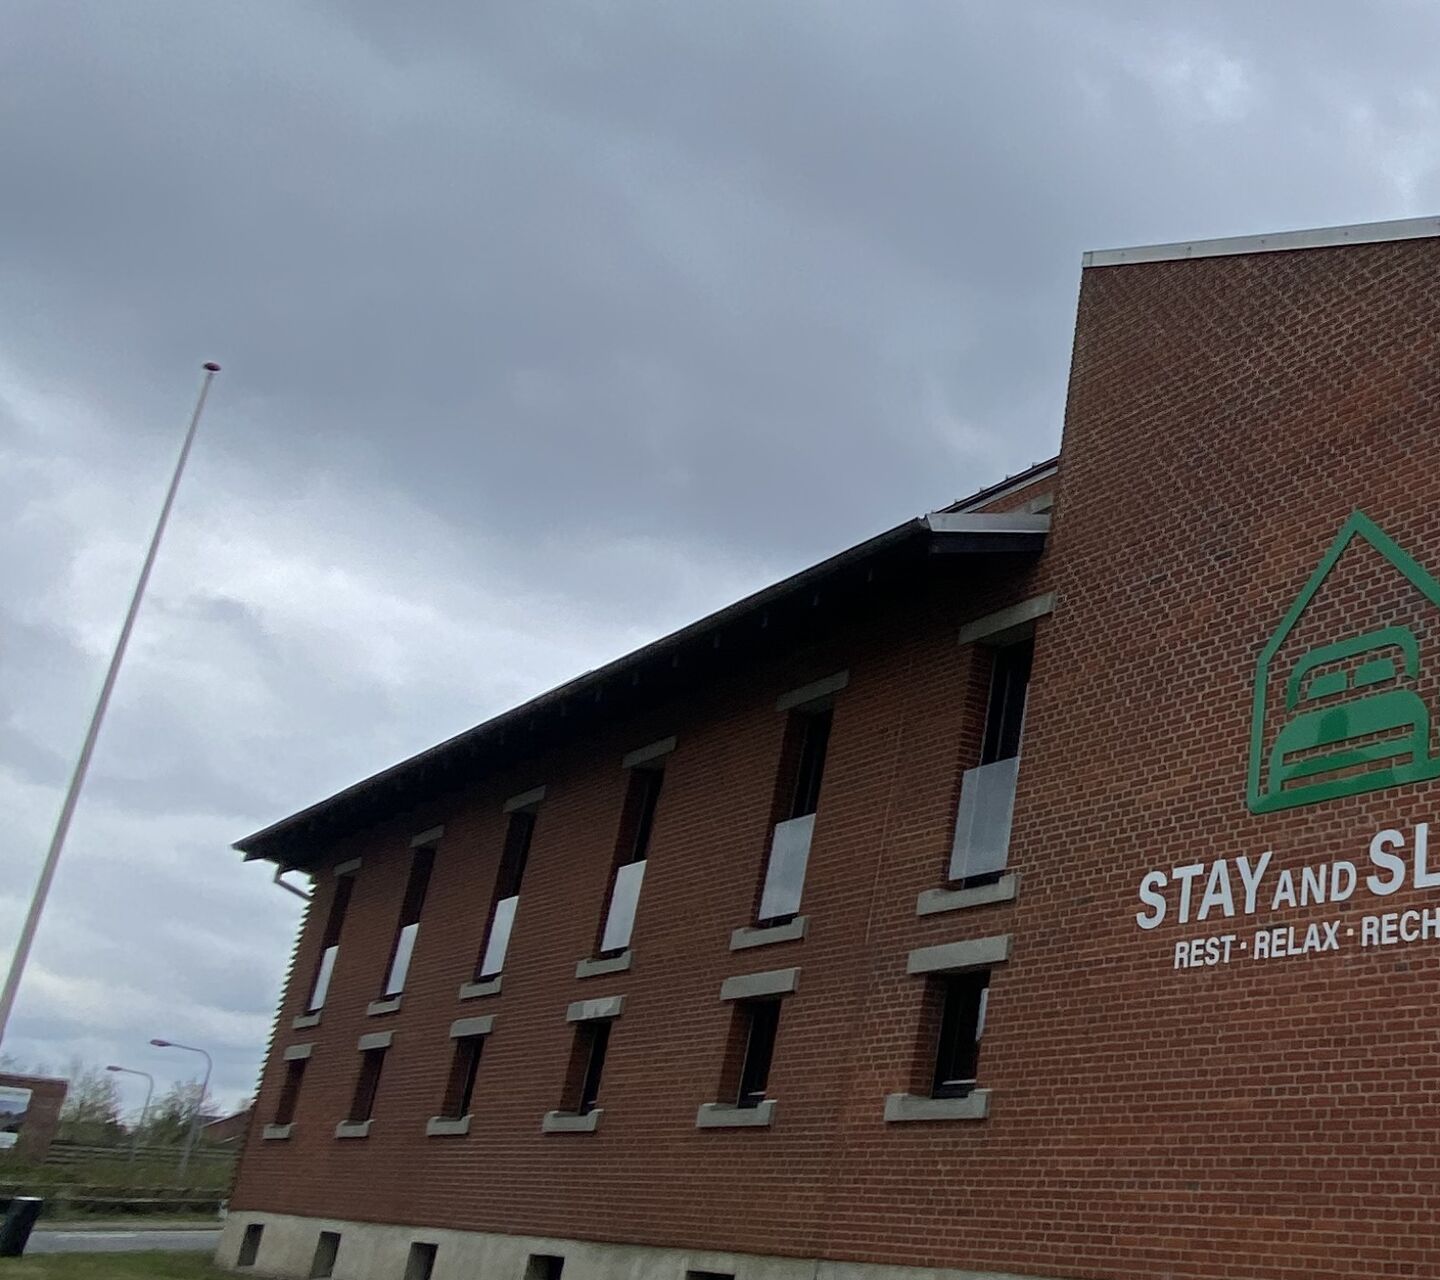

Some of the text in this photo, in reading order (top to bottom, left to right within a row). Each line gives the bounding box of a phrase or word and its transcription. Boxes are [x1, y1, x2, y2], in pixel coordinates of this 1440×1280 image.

[1135, 851, 1273, 930] STAY
[1271, 861, 1357, 910] AND
[1174, 934, 1236, 969] REST
[1253, 920, 1341, 960] RELAX
